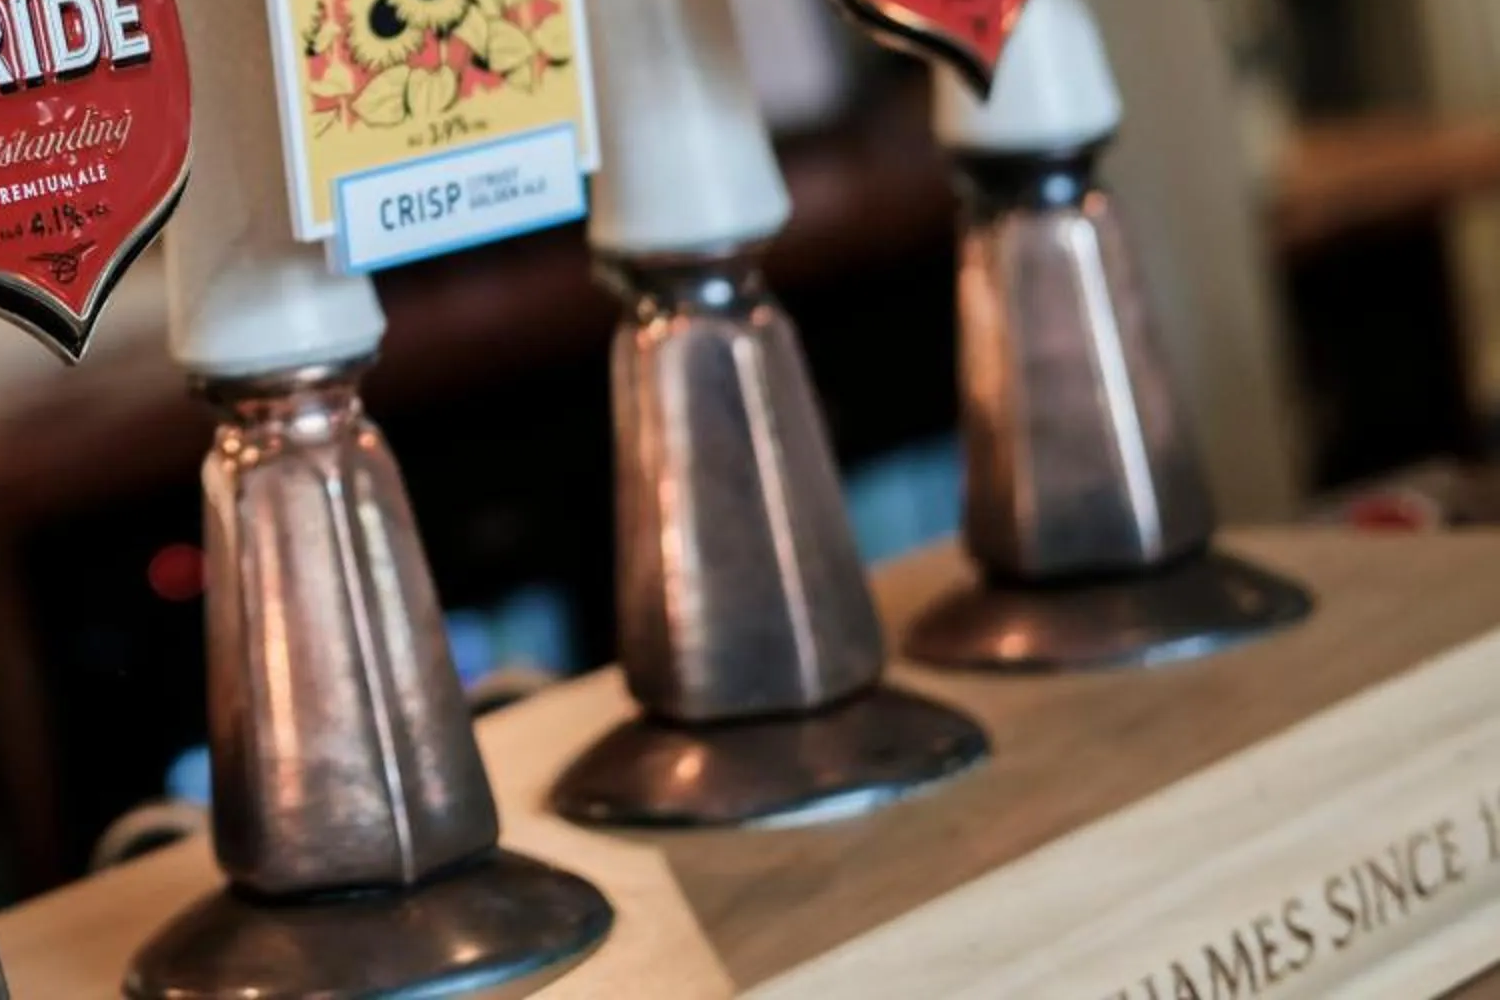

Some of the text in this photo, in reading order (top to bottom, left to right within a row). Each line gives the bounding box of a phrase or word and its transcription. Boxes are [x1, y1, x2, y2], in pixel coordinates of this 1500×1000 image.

[78, 164, 108, 186] ALE
[30, 203, 85, 237] 4.1%
[379, 182, 462, 232] CRISP
[1110, 898, 1315, 1000] AMES
[1324, 818, 1467, 950] SINCE
